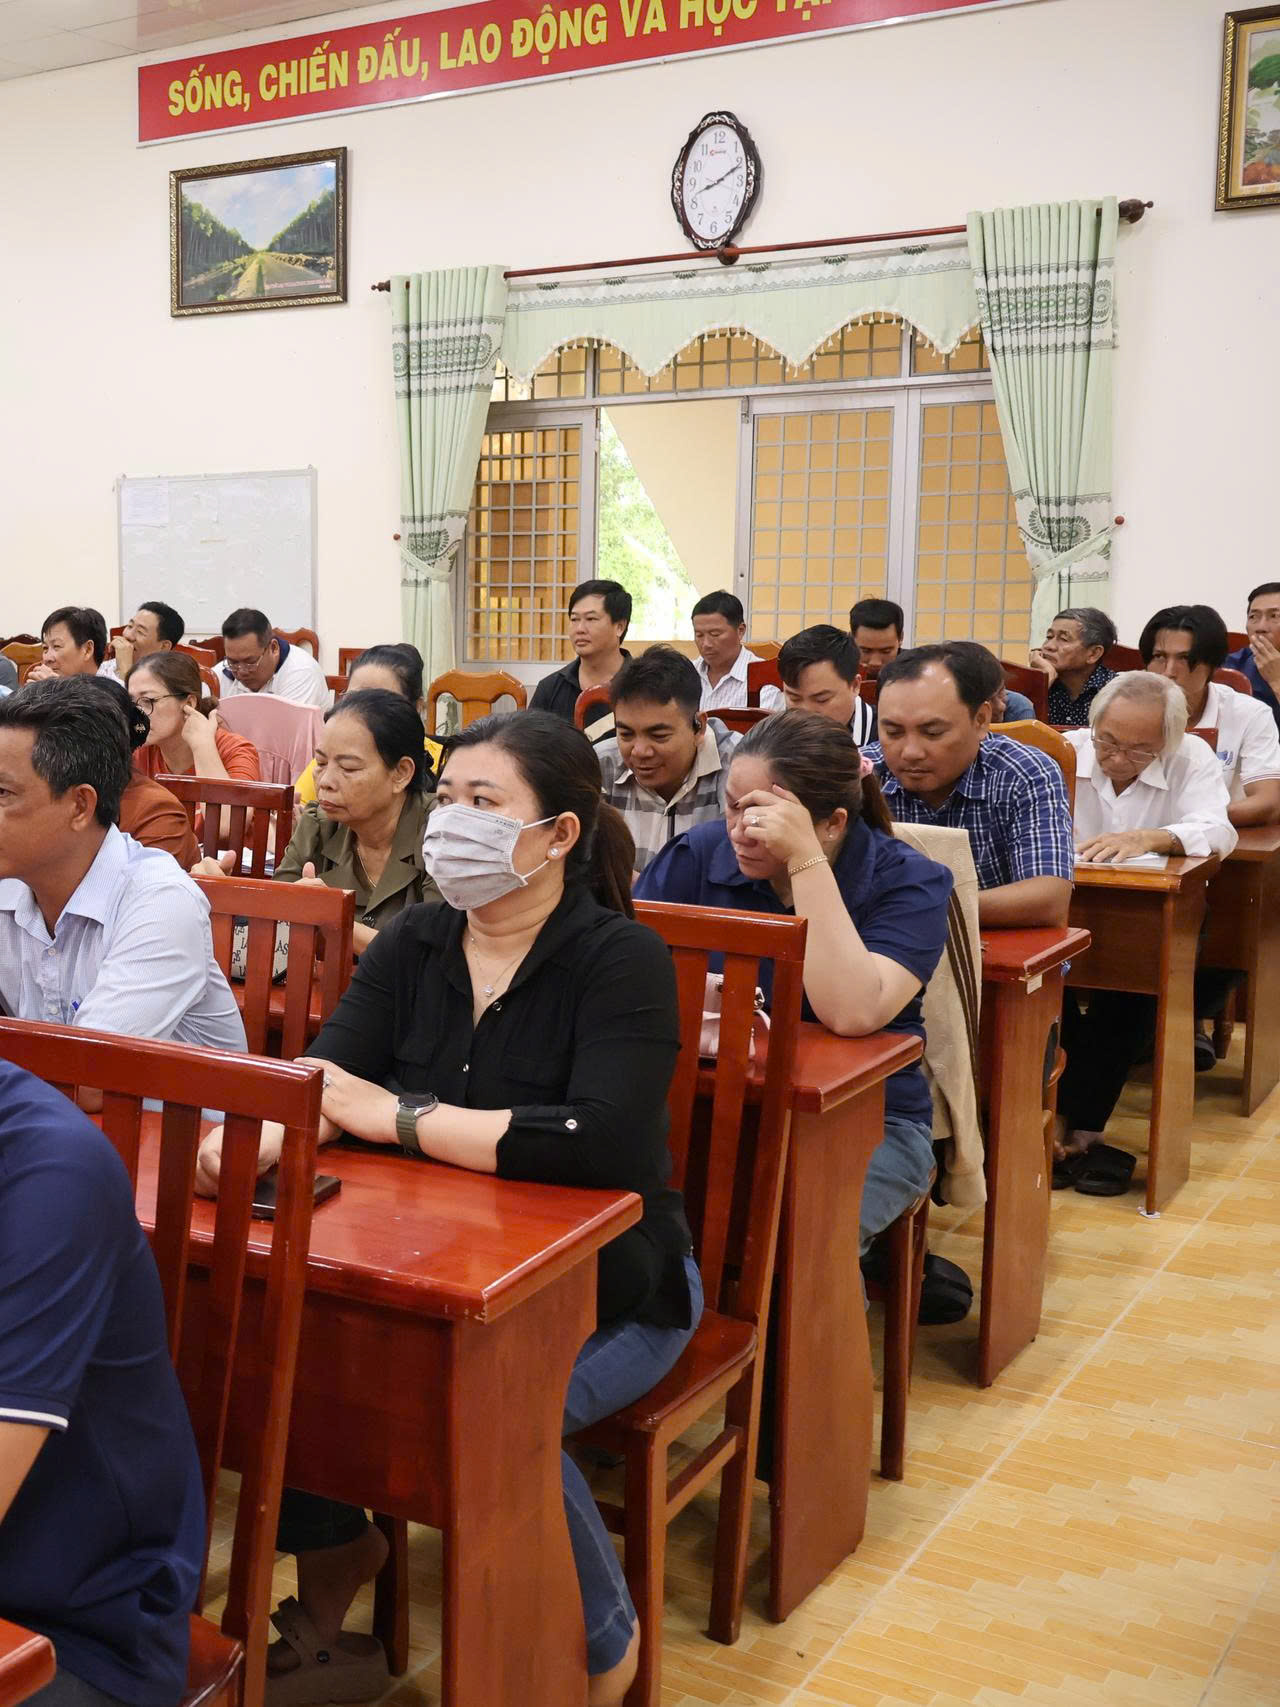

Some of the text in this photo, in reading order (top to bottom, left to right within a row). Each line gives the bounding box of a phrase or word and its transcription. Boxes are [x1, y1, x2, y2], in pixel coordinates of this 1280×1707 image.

[168, 63, 251, 116] SỐNG,
[259, 40, 349, 101] CHIẾN
[357, 27, 429, 82] ĐẤU,
[440, 23, 502, 70] LAO
[511, 3, 608, 65] ĐỘNG
[714, 131, 726, 144] 12
[701, 143, 708, 156] 11
[734, 141, 738, 153] 1
[693, 160, 702, 173] 10
[736, 157, 743, 168] 2
[690, 177, 696, 192] 9
[736, 175, 743, 187] 3
[691, 196, 698, 209] 8
[733, 194, 739, 206] 4
[697, 213, 704, 225] 7
[725, 211, 732, 223] 5
[710, 221, 718, 234] 6
